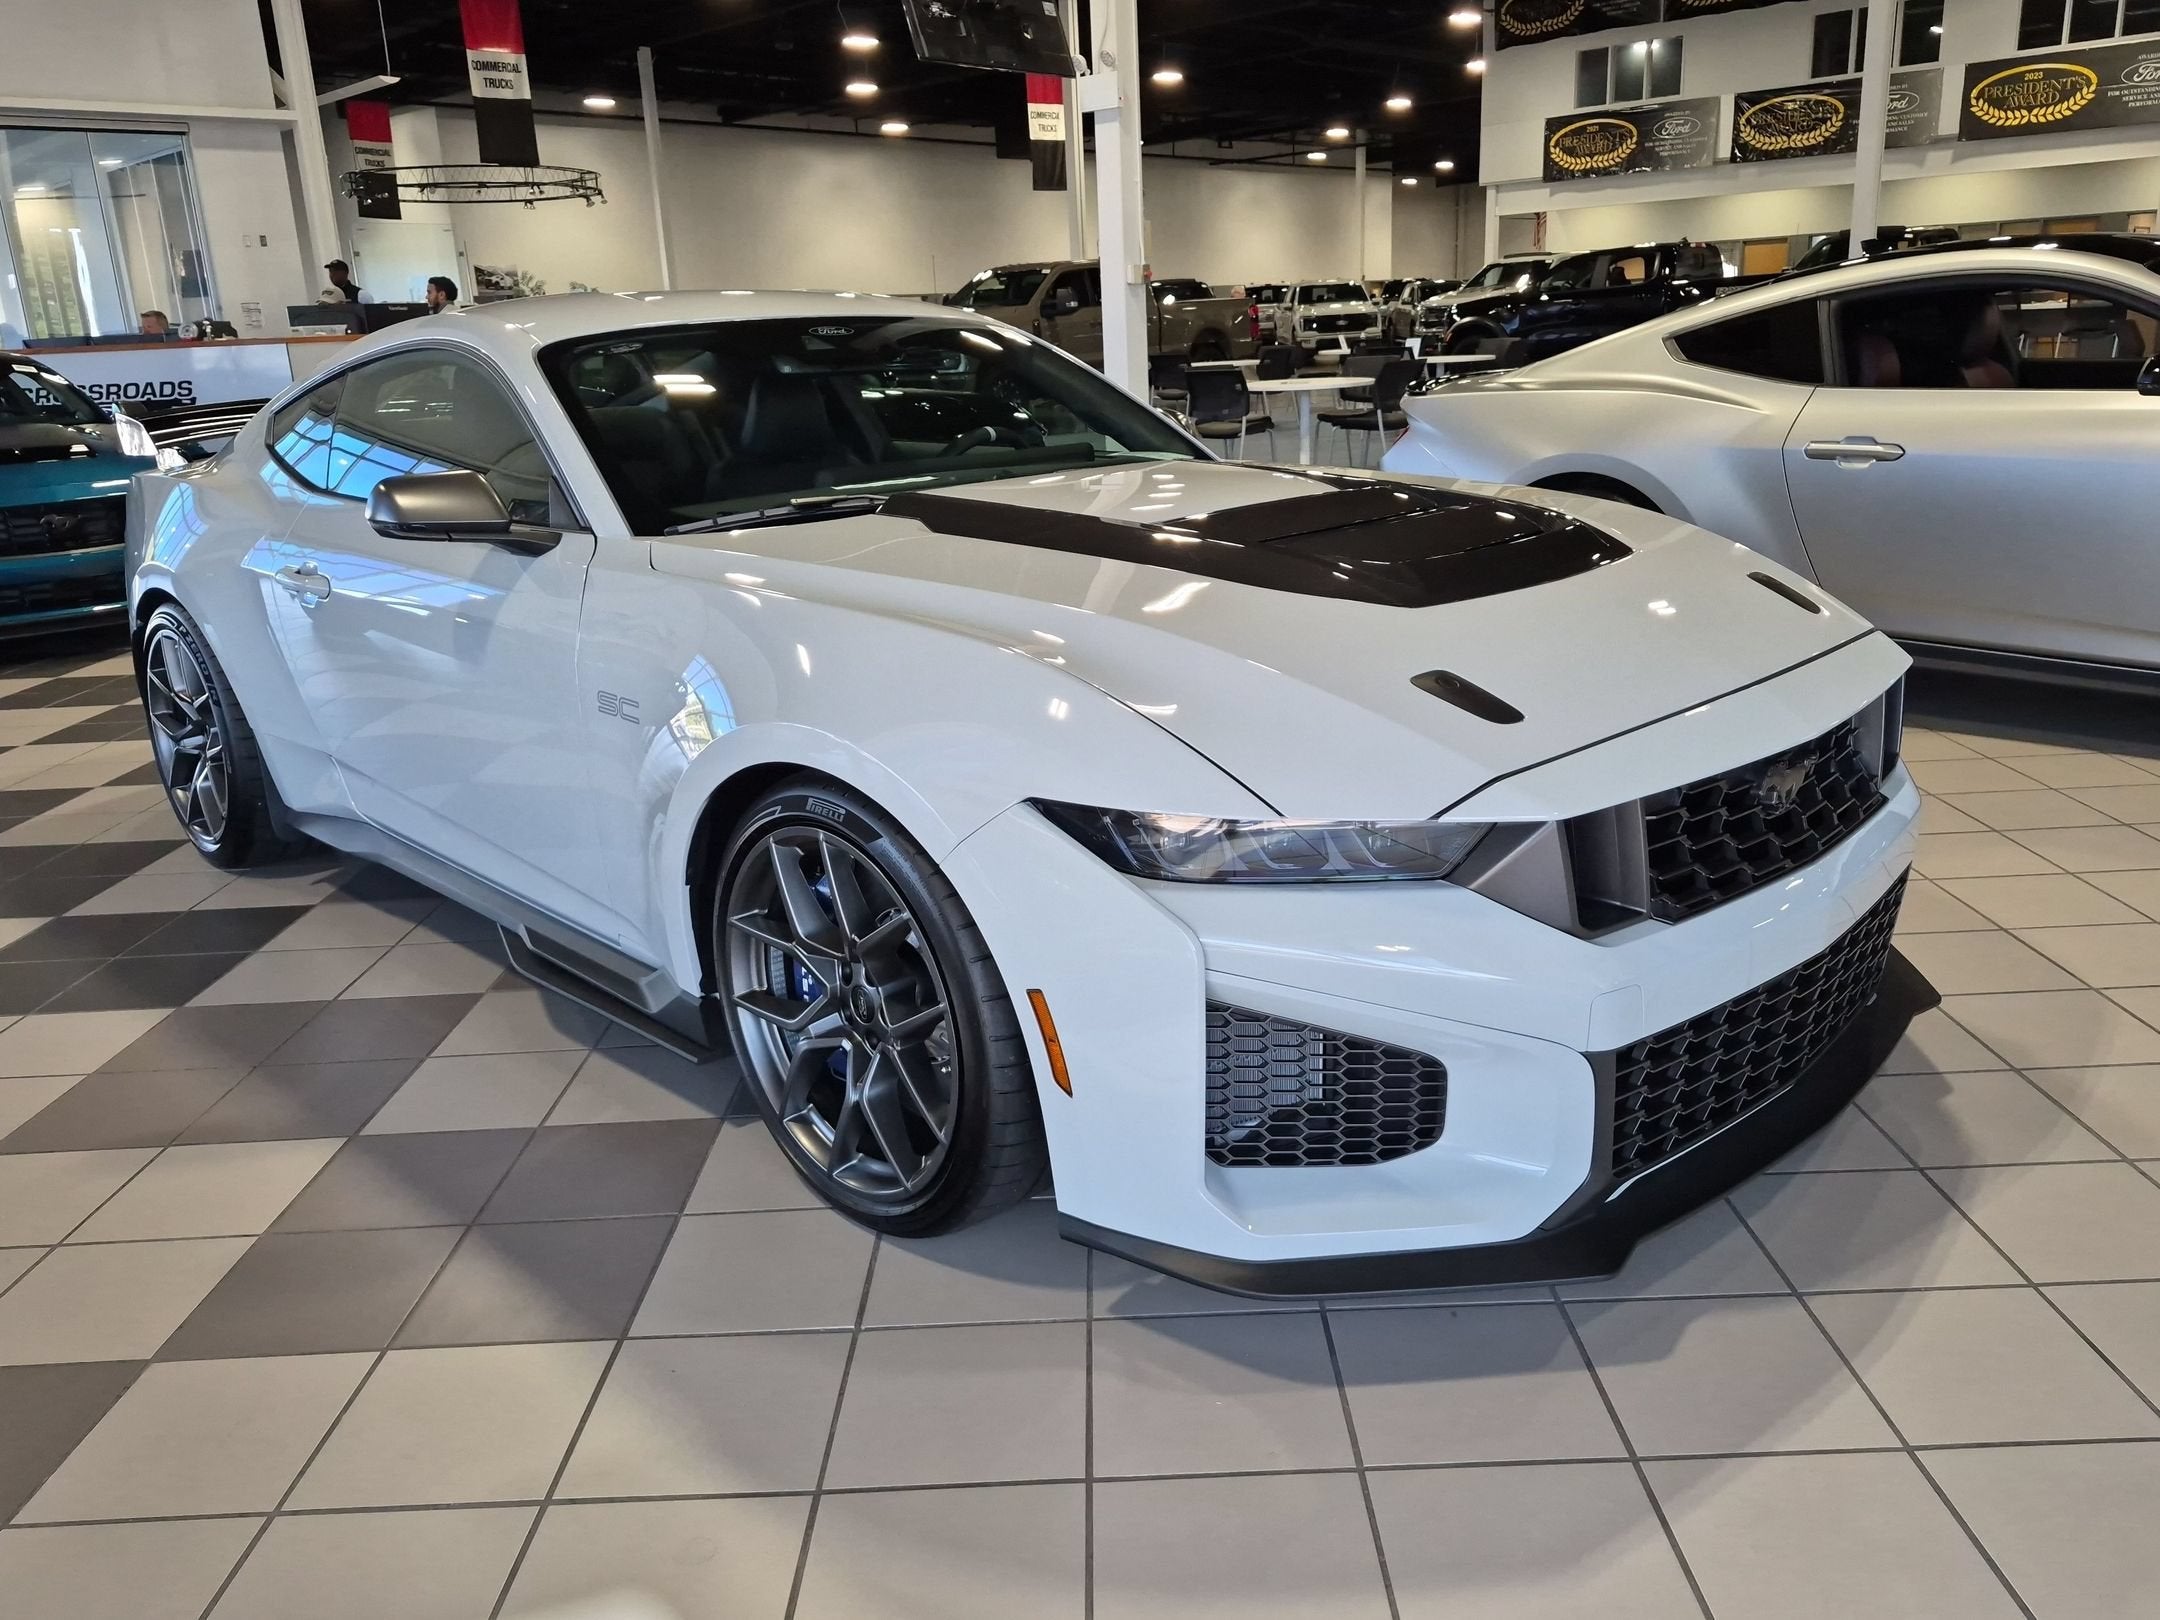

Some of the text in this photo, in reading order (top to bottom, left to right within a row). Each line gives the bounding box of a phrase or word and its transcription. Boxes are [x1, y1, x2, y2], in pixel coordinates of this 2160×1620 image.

[471, 60, 522, 73] COMMERCIAL
[483, 77, 514, 89] TRUCKS
[2024, 72, 2043, 80] 2023
[1984, 75, 2087, 99] PRESIDENT'S
[2004, 91, 2060, 108] AWARD
[1661, 119, 1691, 136] Ford
[805, 797, 846, 823] PIRELLI
